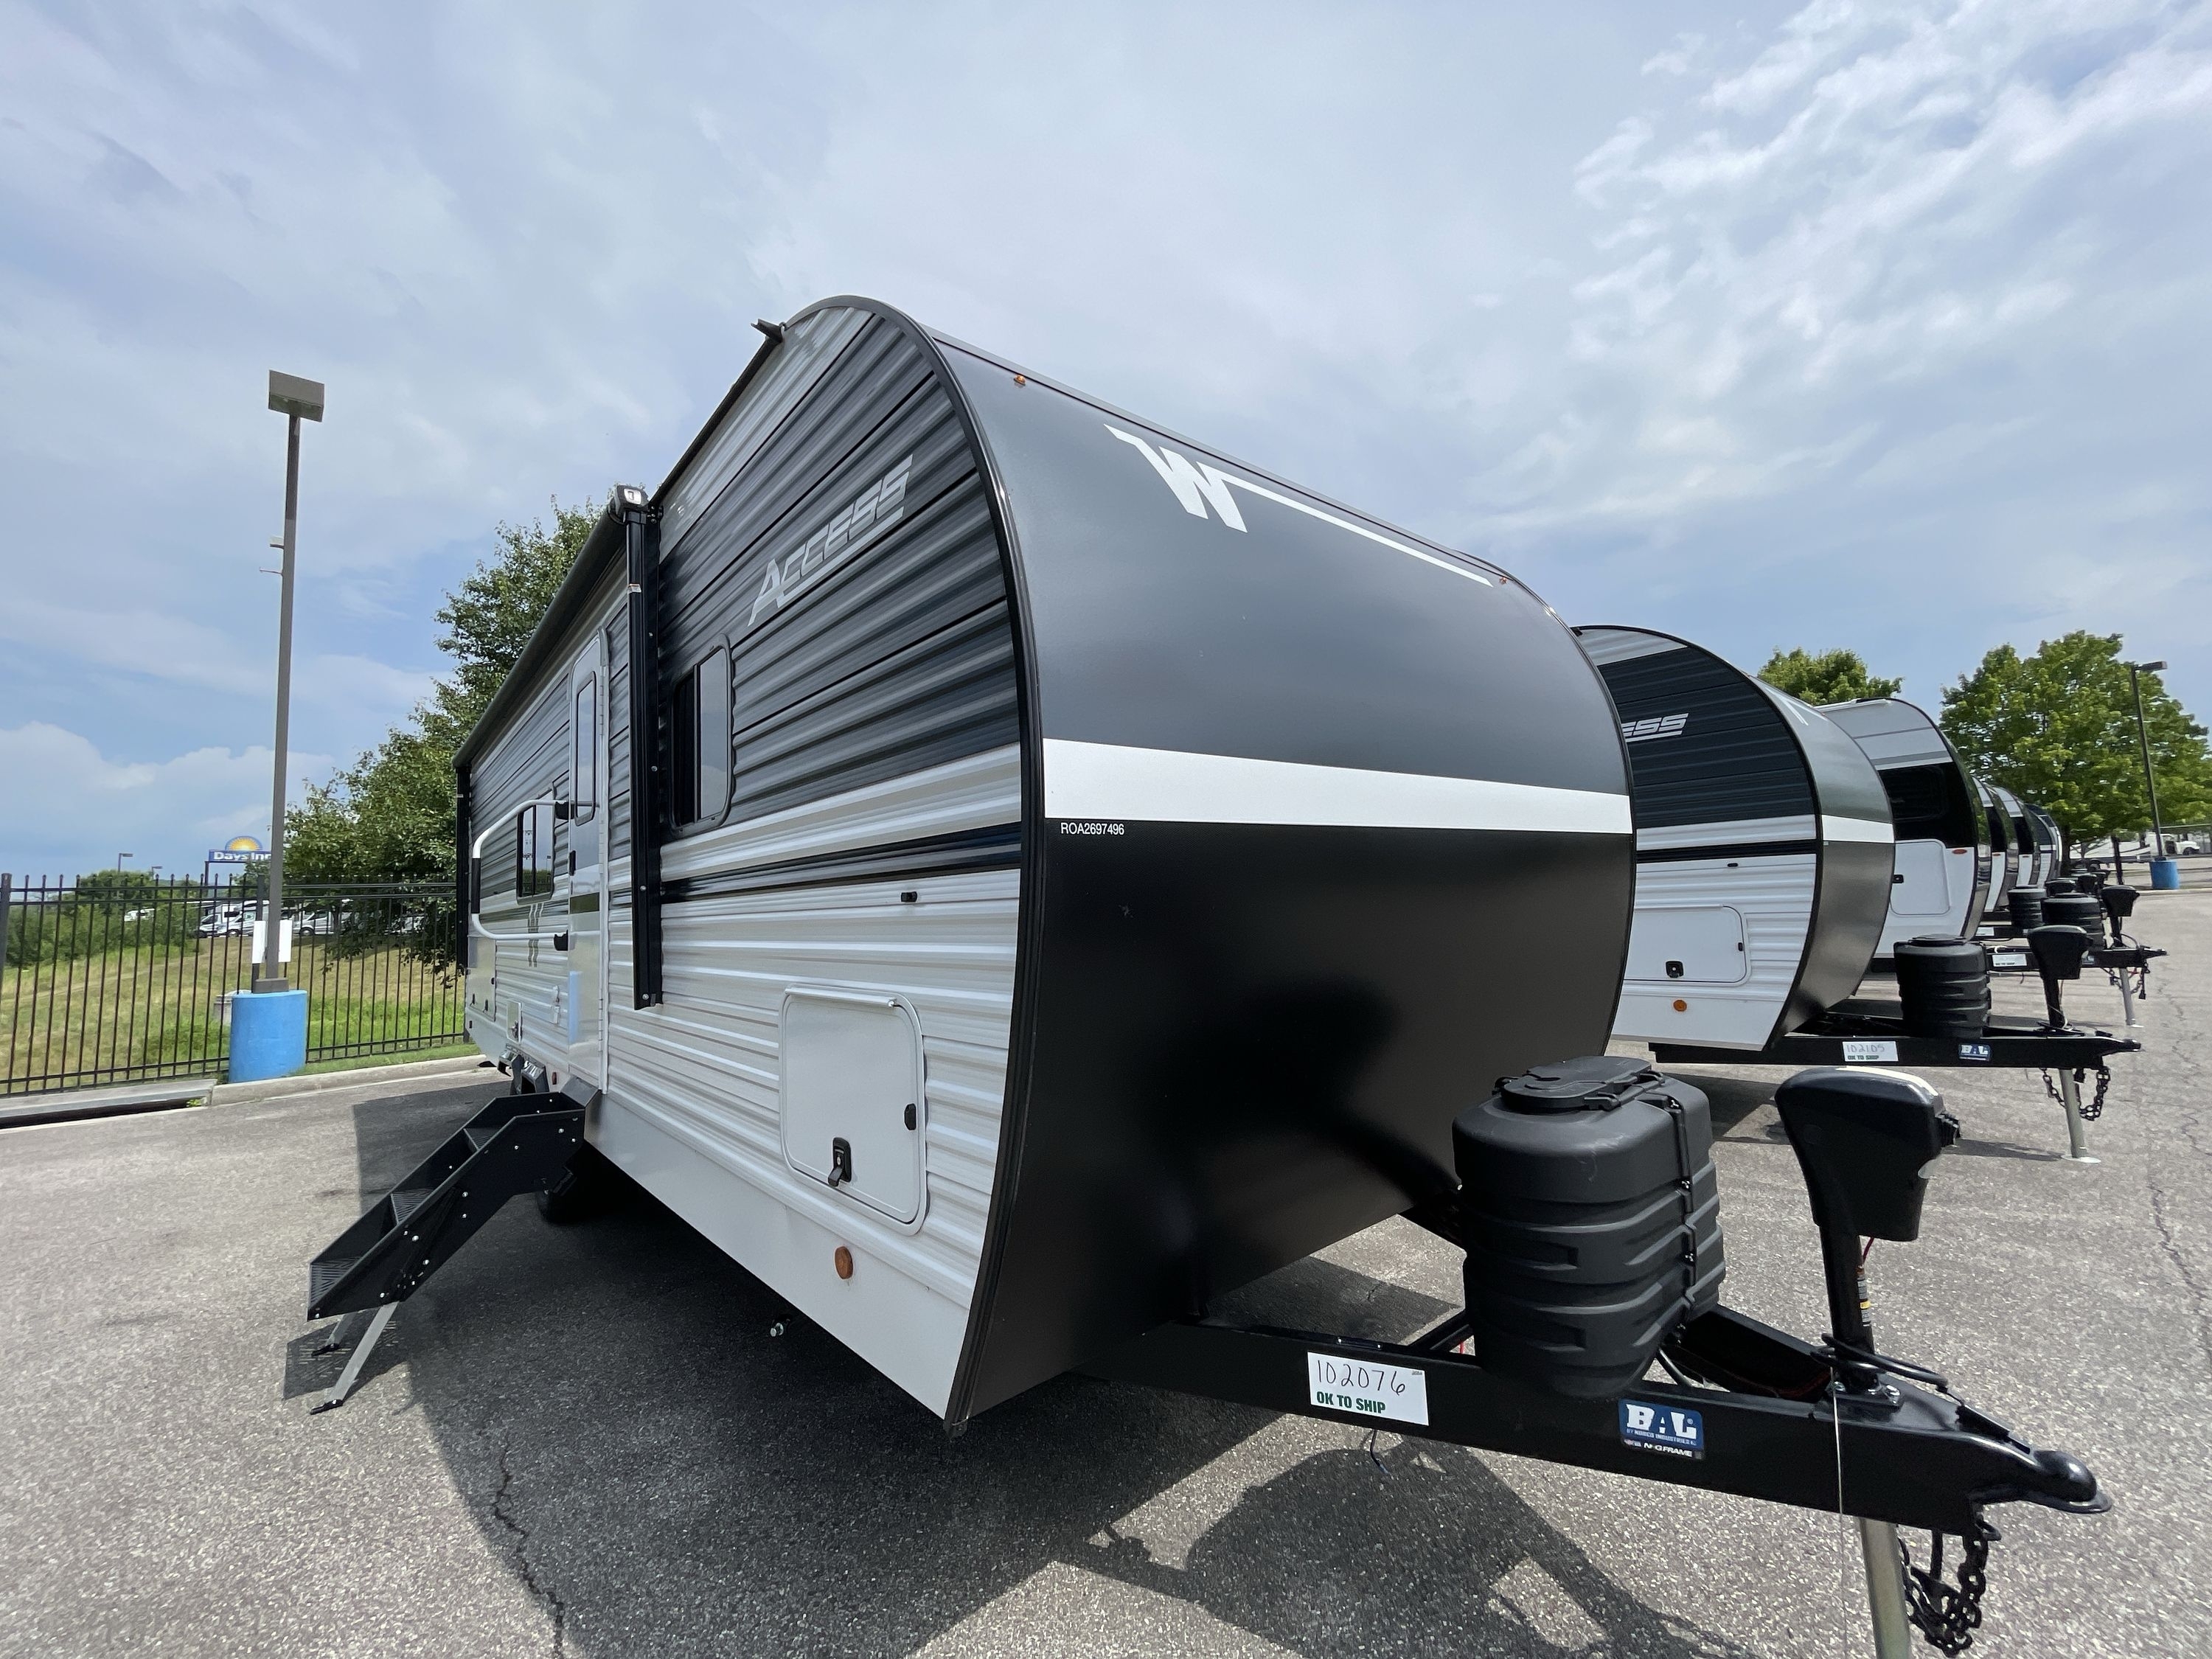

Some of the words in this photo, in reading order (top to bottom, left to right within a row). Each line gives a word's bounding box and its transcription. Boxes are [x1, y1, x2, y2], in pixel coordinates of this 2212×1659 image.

[1060, 822, 1125, 835] ROA2697496
[213, 851, 248, 861] Days
[1317, 1359, 1405, 1397] 102076
[1316, 1391, 1335, 1405] OK
[1336, 1394, 1352, 1408] TO
[1355, 1397, 1386, 1414] SHIP
[1626, 1404, 1697, 1439] BAL
